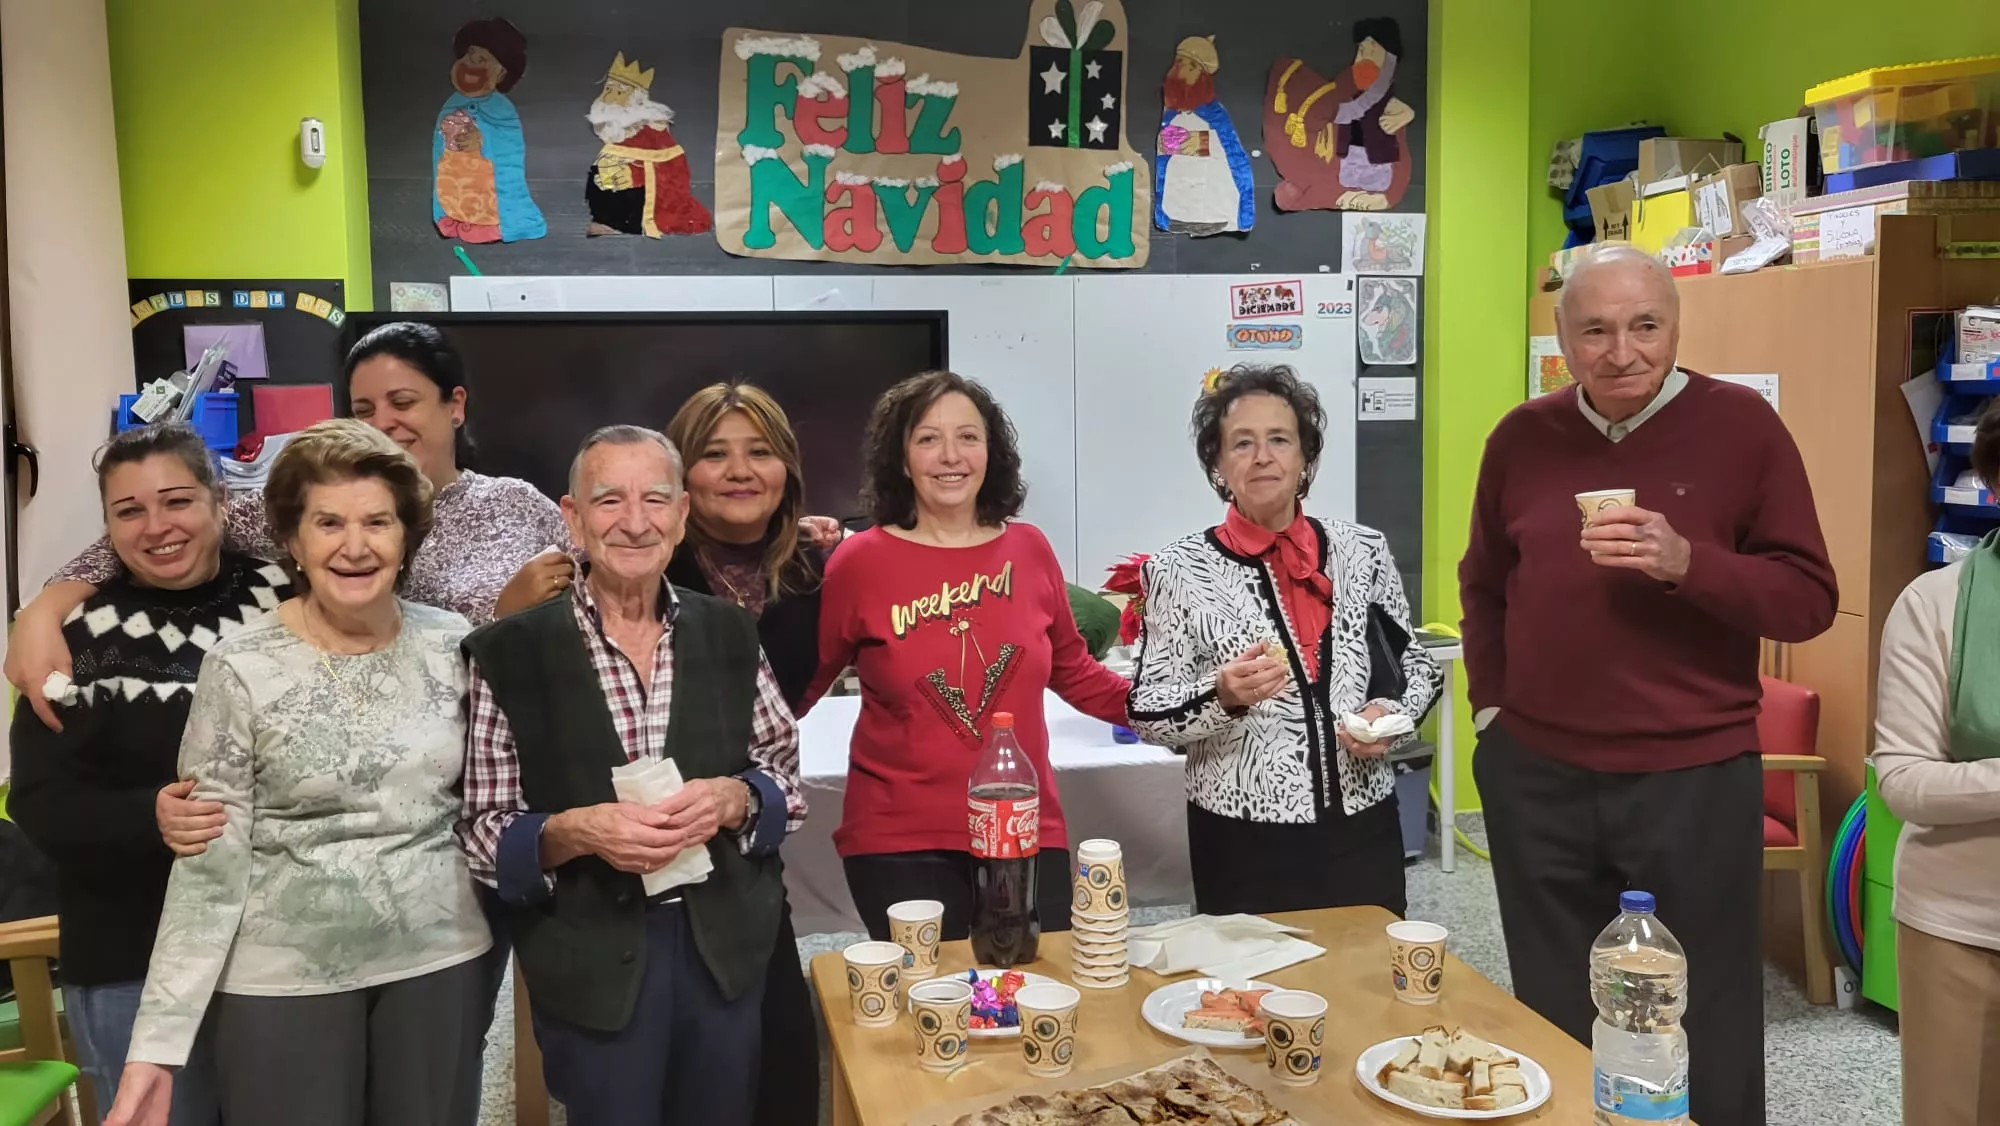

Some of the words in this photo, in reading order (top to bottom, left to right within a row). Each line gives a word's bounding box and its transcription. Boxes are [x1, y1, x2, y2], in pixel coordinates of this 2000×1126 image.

[735, 36, 961, 155] Feliz
[1765, 142, 1773, 193] BINGO
[1780, 148, 1791, 189] LOTO
[742, 152, 1135, 259] Navidad
[135, 289, 218, 319] MPLES
[234, 292, 284, 307] DEL
[1239, 301, 1296, 315] DICIEMBRE
[1317, 302, 1352, 315] 2023
[1236, 327, 1293, 345] OTOÑO
[891, 560, 1013, 638] weekend
